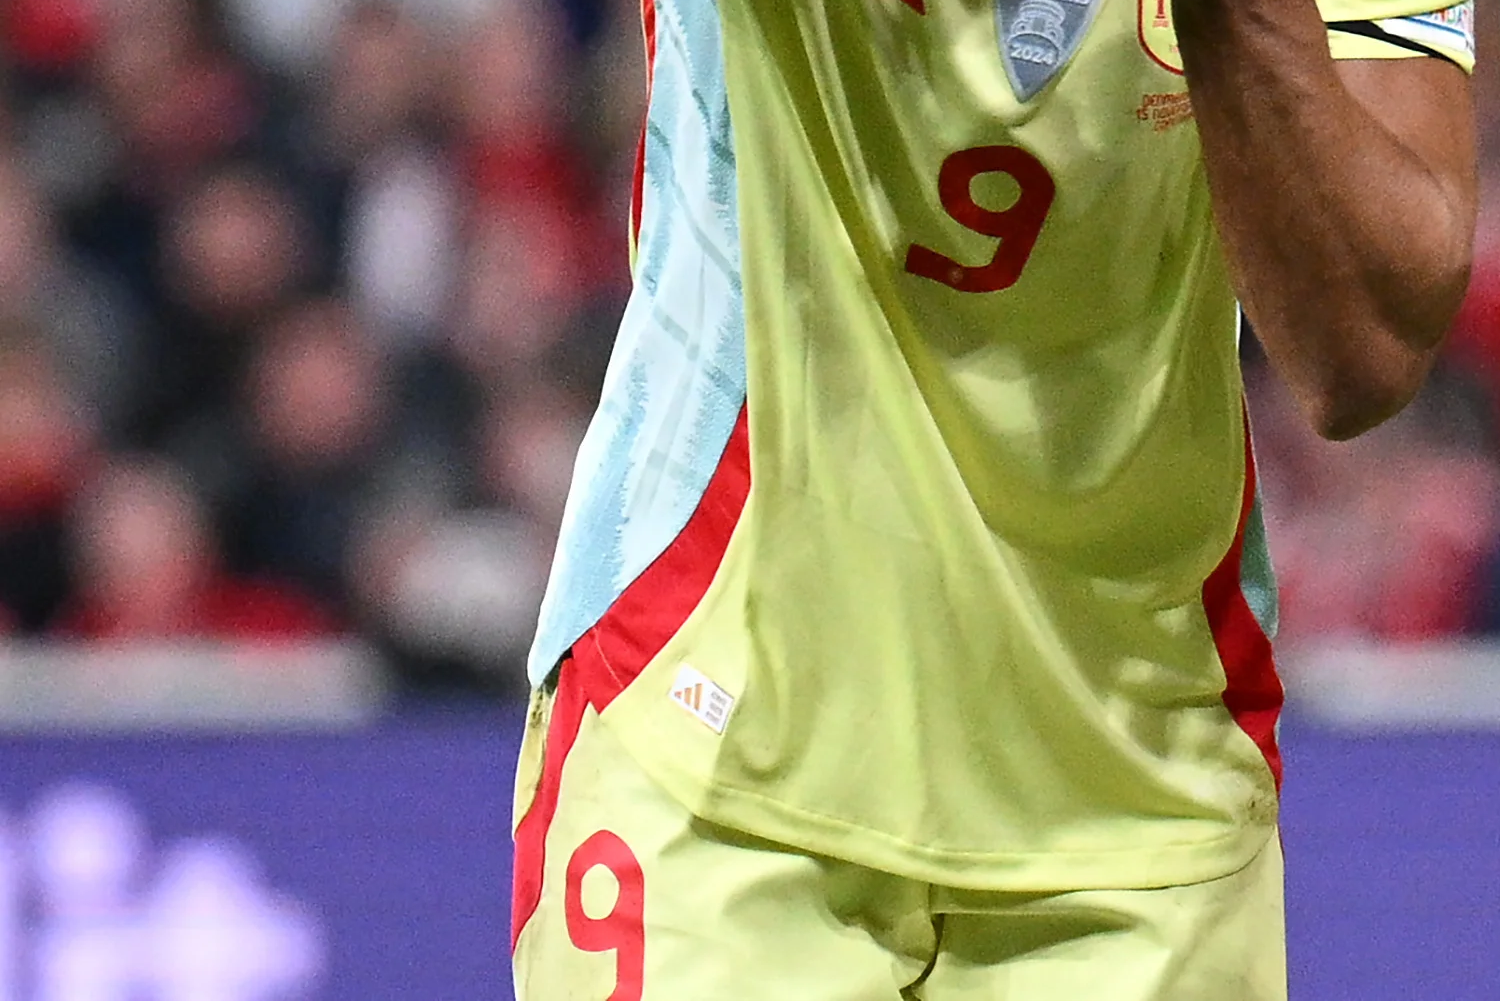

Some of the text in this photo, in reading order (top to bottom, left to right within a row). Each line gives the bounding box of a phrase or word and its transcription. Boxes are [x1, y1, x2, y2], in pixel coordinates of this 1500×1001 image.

[1010, 42, 1054, 65] 2024
[904, 144, 1056, 294] 9
[565, 828, 645, 1001] 9
